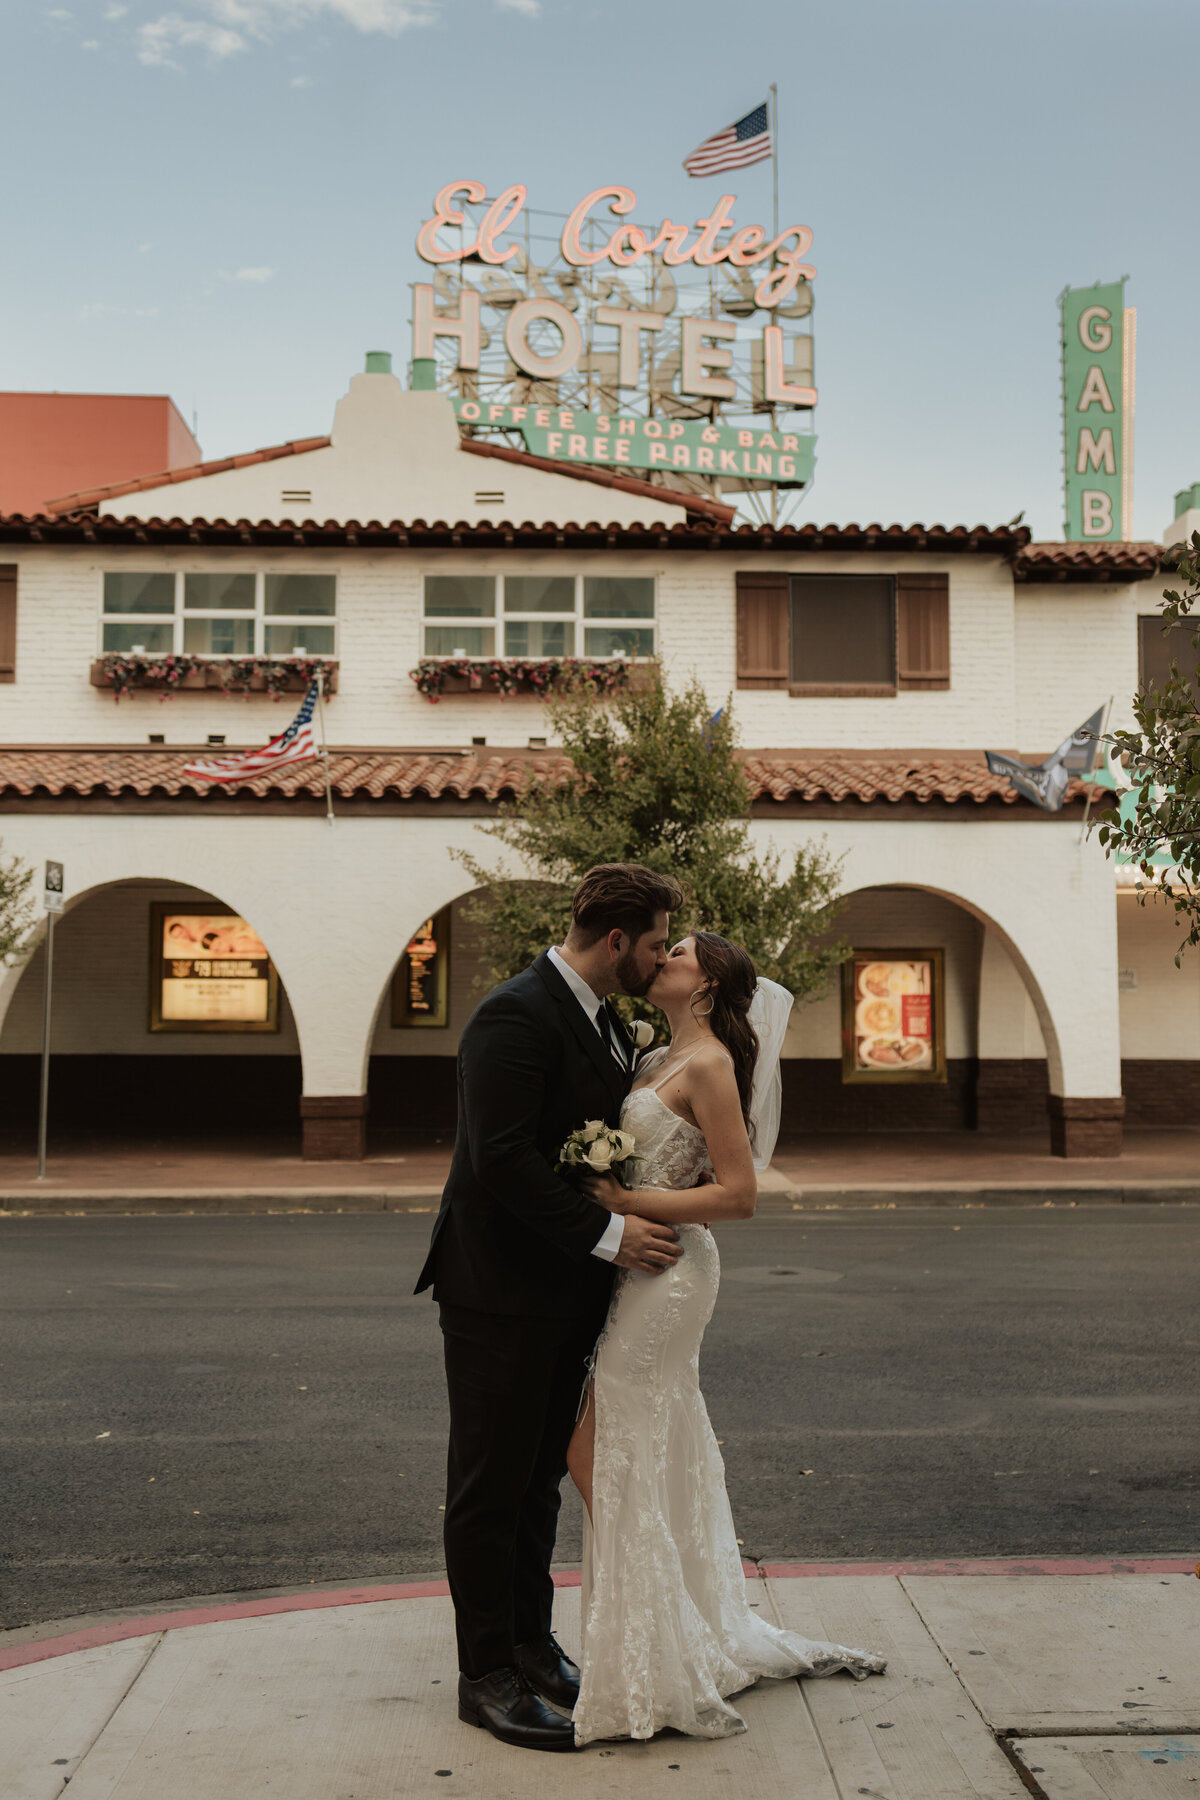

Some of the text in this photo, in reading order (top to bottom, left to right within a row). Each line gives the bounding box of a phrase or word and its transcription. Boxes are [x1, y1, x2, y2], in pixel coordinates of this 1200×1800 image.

[416, 180, 818, 308] El Cortez
[413, 284, 818, 405] HOTEL
[547, 432, 797, 478] FREE PARKING
[596, 415, 685, 440] SHOP
[701, 425, 721, 444] &
[738, 430, 800, 452] BAR
[1076, 305, 1116, 537] GAMB
